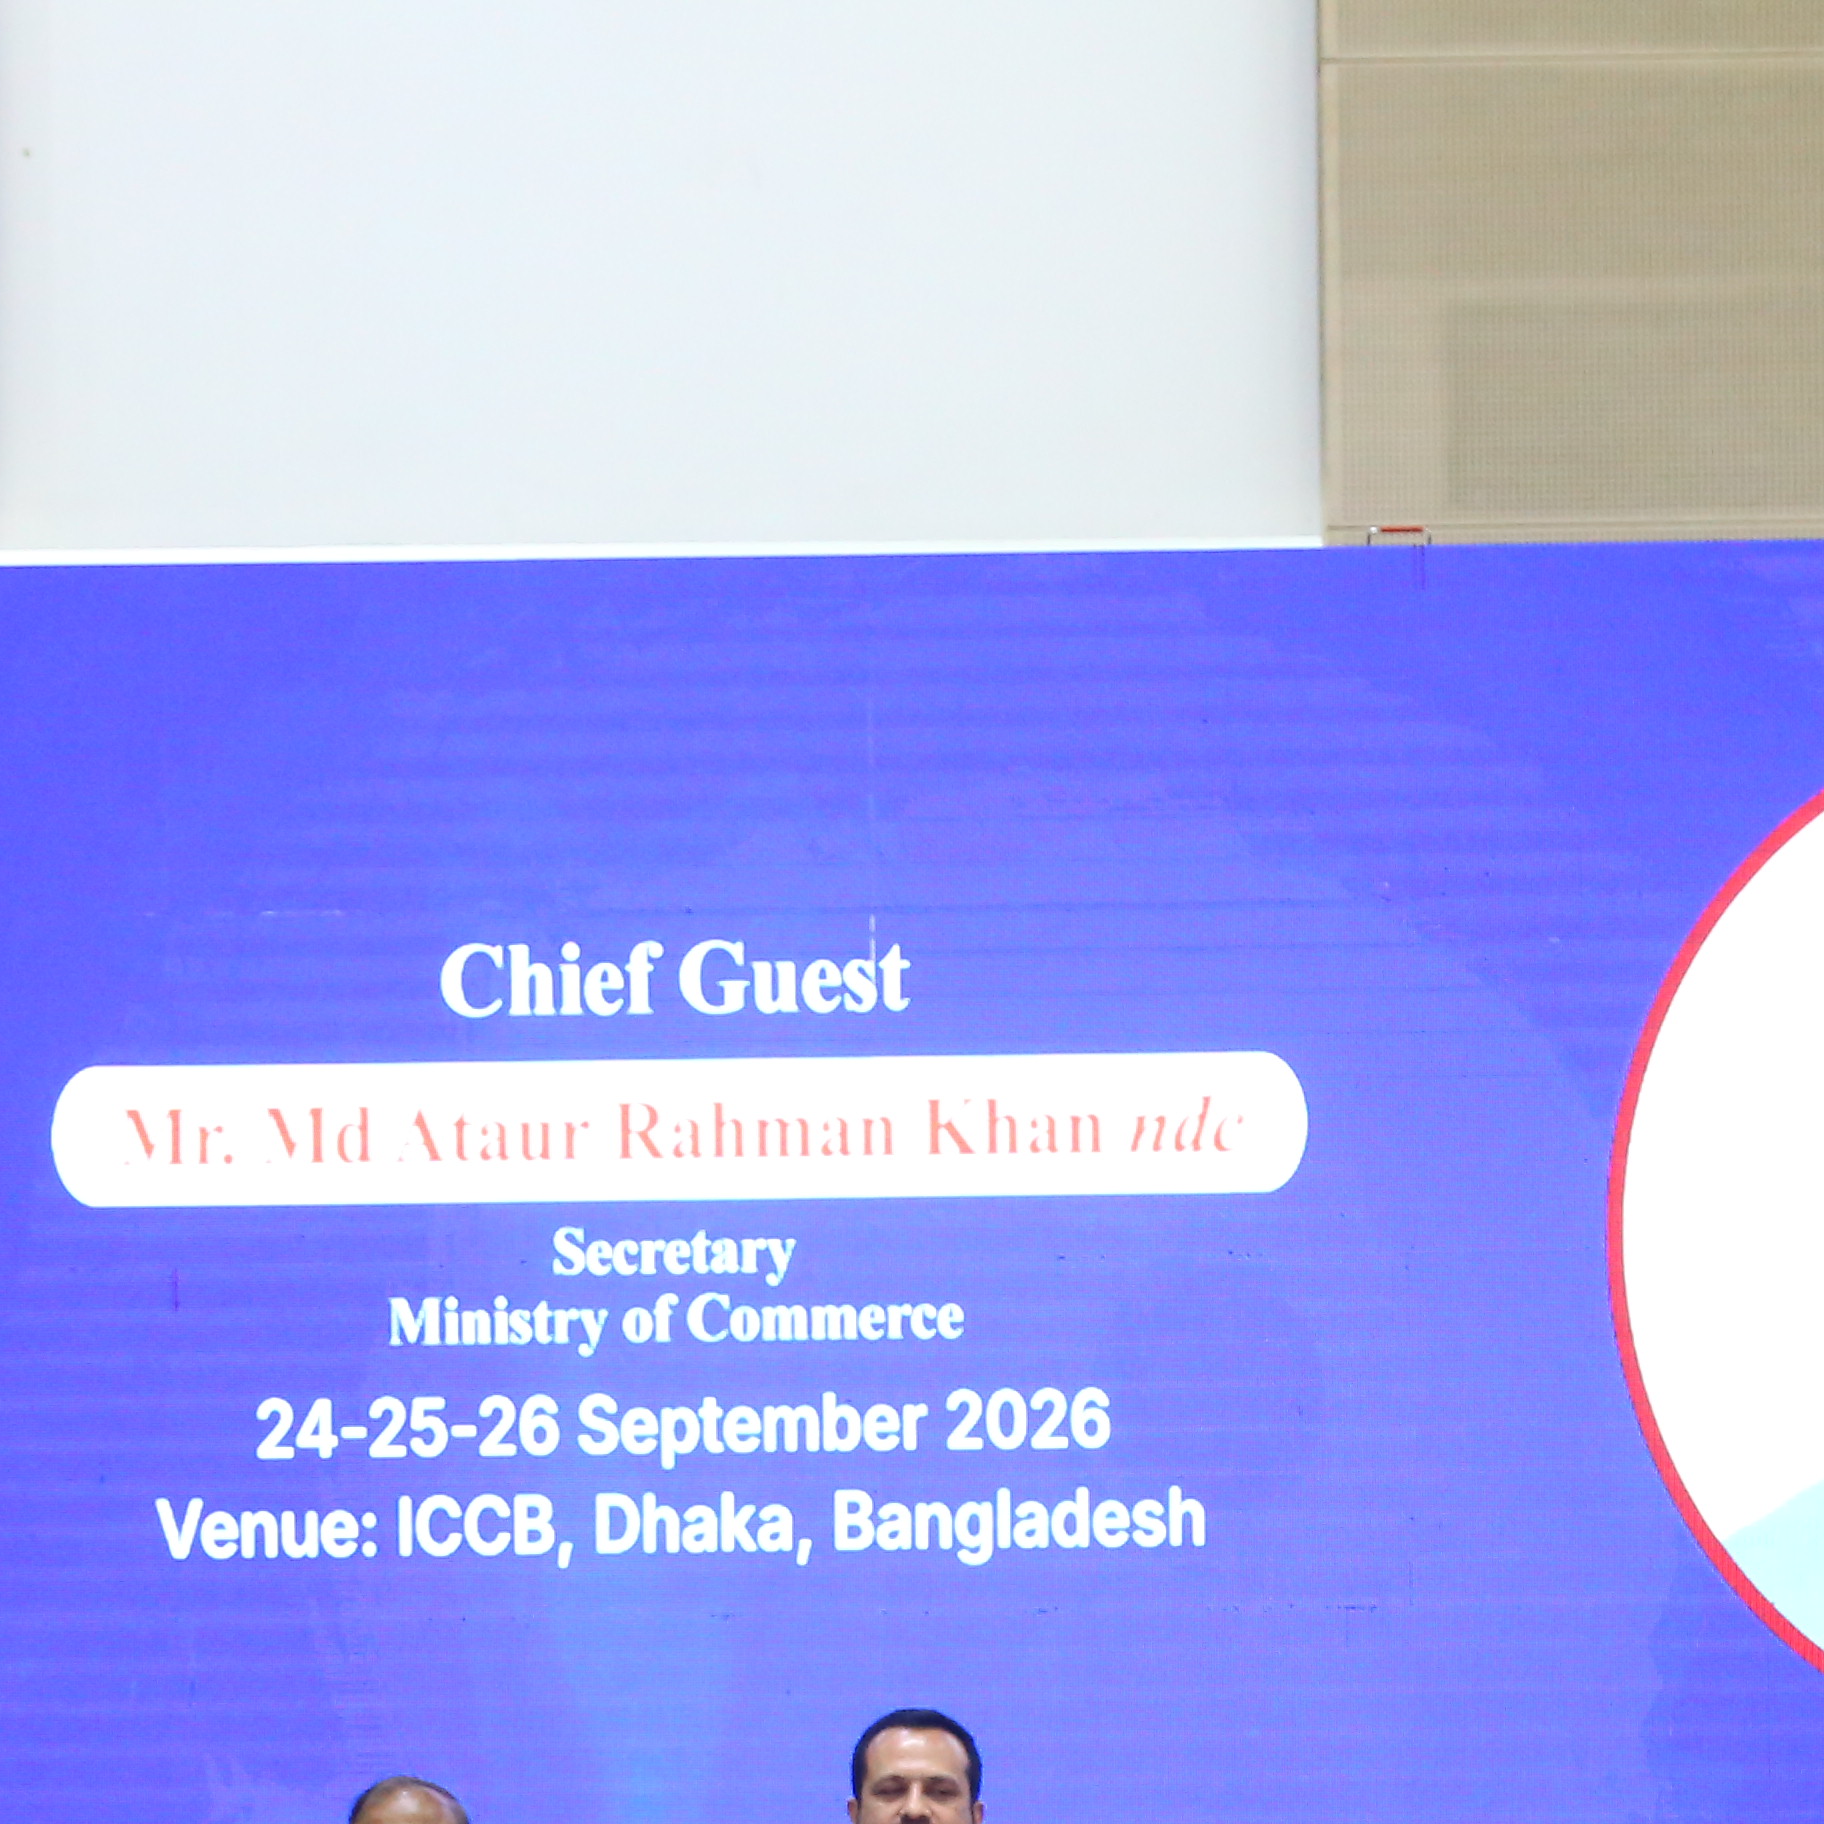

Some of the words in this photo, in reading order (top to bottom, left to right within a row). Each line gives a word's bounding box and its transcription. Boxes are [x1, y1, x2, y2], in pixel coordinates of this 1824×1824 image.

[440, 940, 665, 1018] Chief
[678, 939, 912, 1016] Guest
[126, 1108, 233, 1165] Mr.
[267, 1106, 371, 1164] Md
[397, 1110, 590, 1162] Ataur
[619, 1102, 893, 1160] Rahman
[928, 1098, 1101, 1155] Khan
[1130, 1095, 1244, 1153] ndc
[552, 1227, 797, 1287] Secretary
[386, 1295, 609, 1357] Ministry
[622, 1292, 680, 1344] of
[686, 1291, 965, 1343] Commerce
[256, 1394, 561, 1459] 24-25-26
[577, 1390, 929, 1471] September
[945, 1386, 1112, 1451] 2026
[154, 1497, 378, 1560] Venue:
[395, 1493, 574, 1569] ICCB,
[595, 1490, 813, 1566] Dhaka,
[833, 1484, 1207, 1567] Bangladesh
